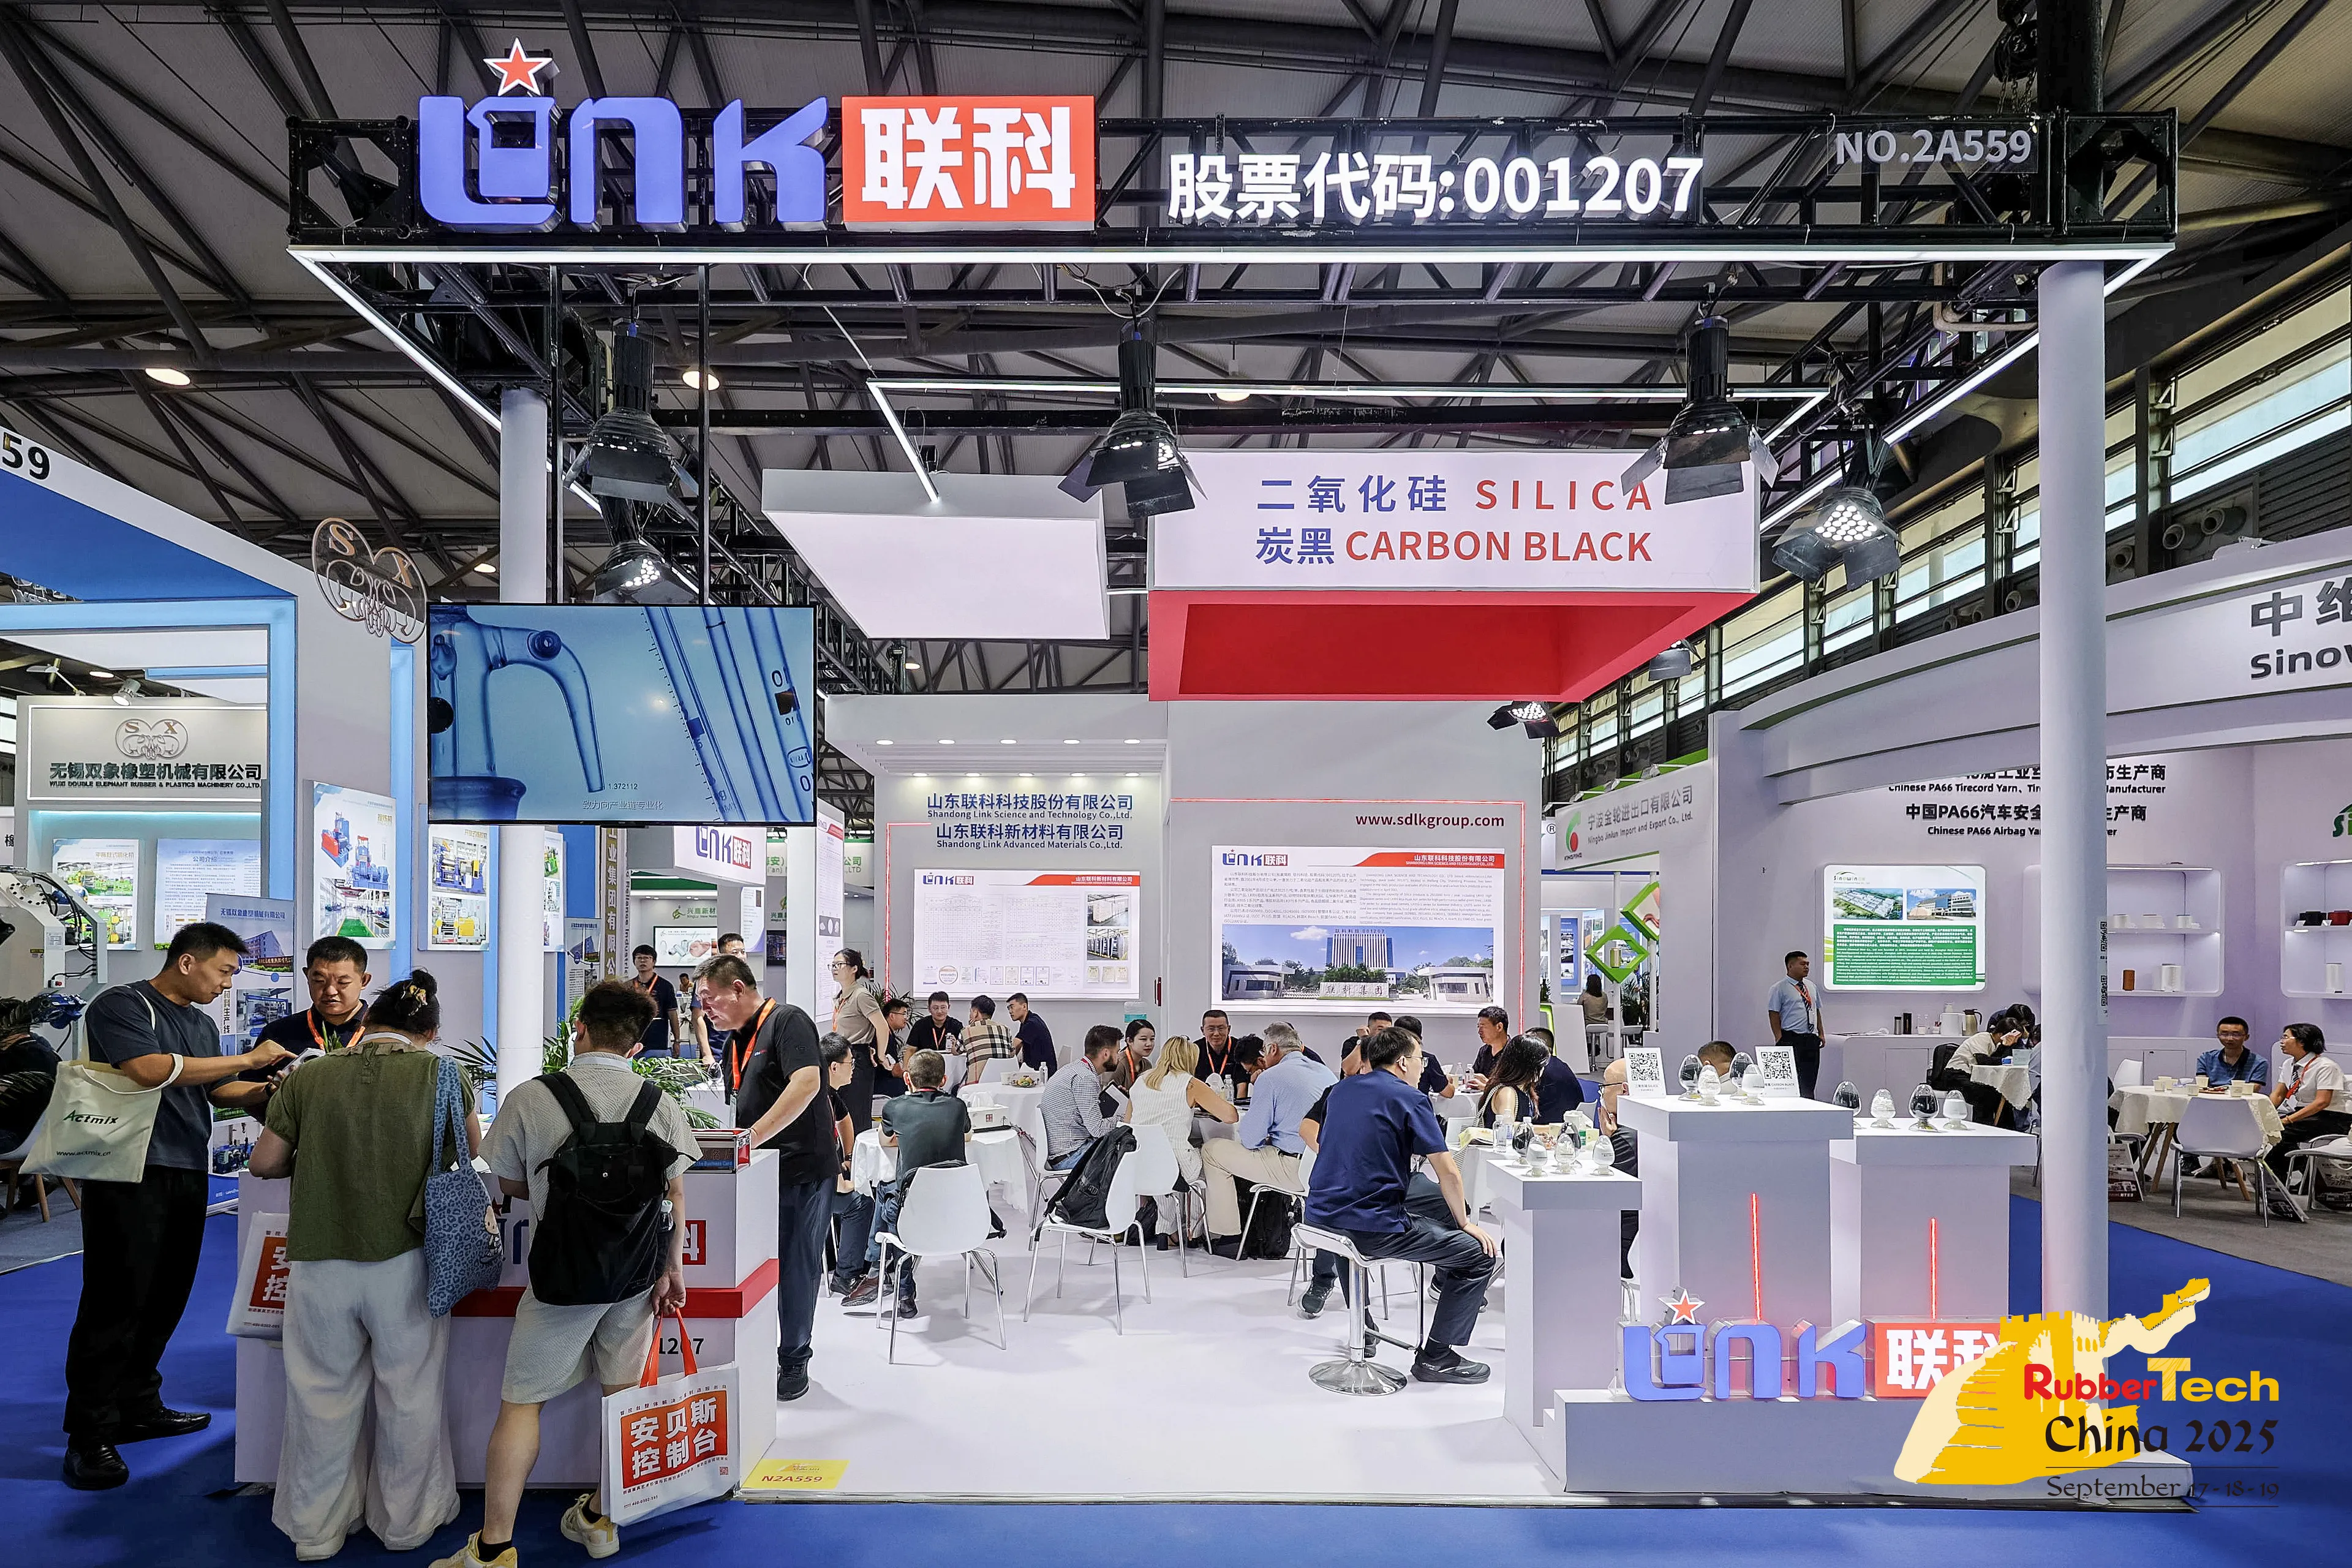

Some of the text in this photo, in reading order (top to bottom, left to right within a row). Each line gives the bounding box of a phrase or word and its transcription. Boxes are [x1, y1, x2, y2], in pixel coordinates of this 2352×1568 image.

[1836, 129, 2034, 167] NO.2A559
[861, 106, 1076, 210] 联科
[1167, 152, 1705, 222] 股票代码:001207
[1256, 475, 1651, 513] 二氧化硅 SILICA
[1256, 527, 1653, 565] 炭黑 CARBON BLACK
[50, 762, 262, 780] 无锡双象橡塑机械有限公司
[1929, 783, 1953, 793] PA66
[1955, 783, 1994, 793] Tirecord
[2027, 783, 2041, 793] Tir
[2106, 784, 2166, 794] anufacturer
[927, 793, 1133, 810] 山东联科科技股份有限公司
[1588, 785, 1693, 831] 宁波金轮进出口有限公司
[927, 810, 1133, 820] Shandong Link Science and Technology Co.,Ltd.
[1355, 813, 1505, 829] www.sdlkgroup.com
[937, 823, 1123, 840] 山东联科新材料有限公司
[1588, 835, 1604, 845] Ningbo
[1620, 828, 1637, 839] Import
[1638, 824, 1648, 832] and
[1681, 811, 1693, 821] Ltd.
[1928, 826, 1965, 835] Chinese
[1967, 826, 1991, 835] PA66
[1993, 826, 2026, 837] Airbag
[2027, 826, 2041, 835] Ya
[937, 840, 1123, 850] Shandong Link Advanced Materials Co.,Ltd.
[1265, 854, 1287, 865] 联科
[1414, 854, 1495, 863] 山东联科科技股份有限公司
[956, 876, 974, 885] 联科
[62, 1109, 119, 1125] Actmix
[630, 1396, 717, 1448] 安贝斯
[631, 1428, 718, 1479] 控制台
